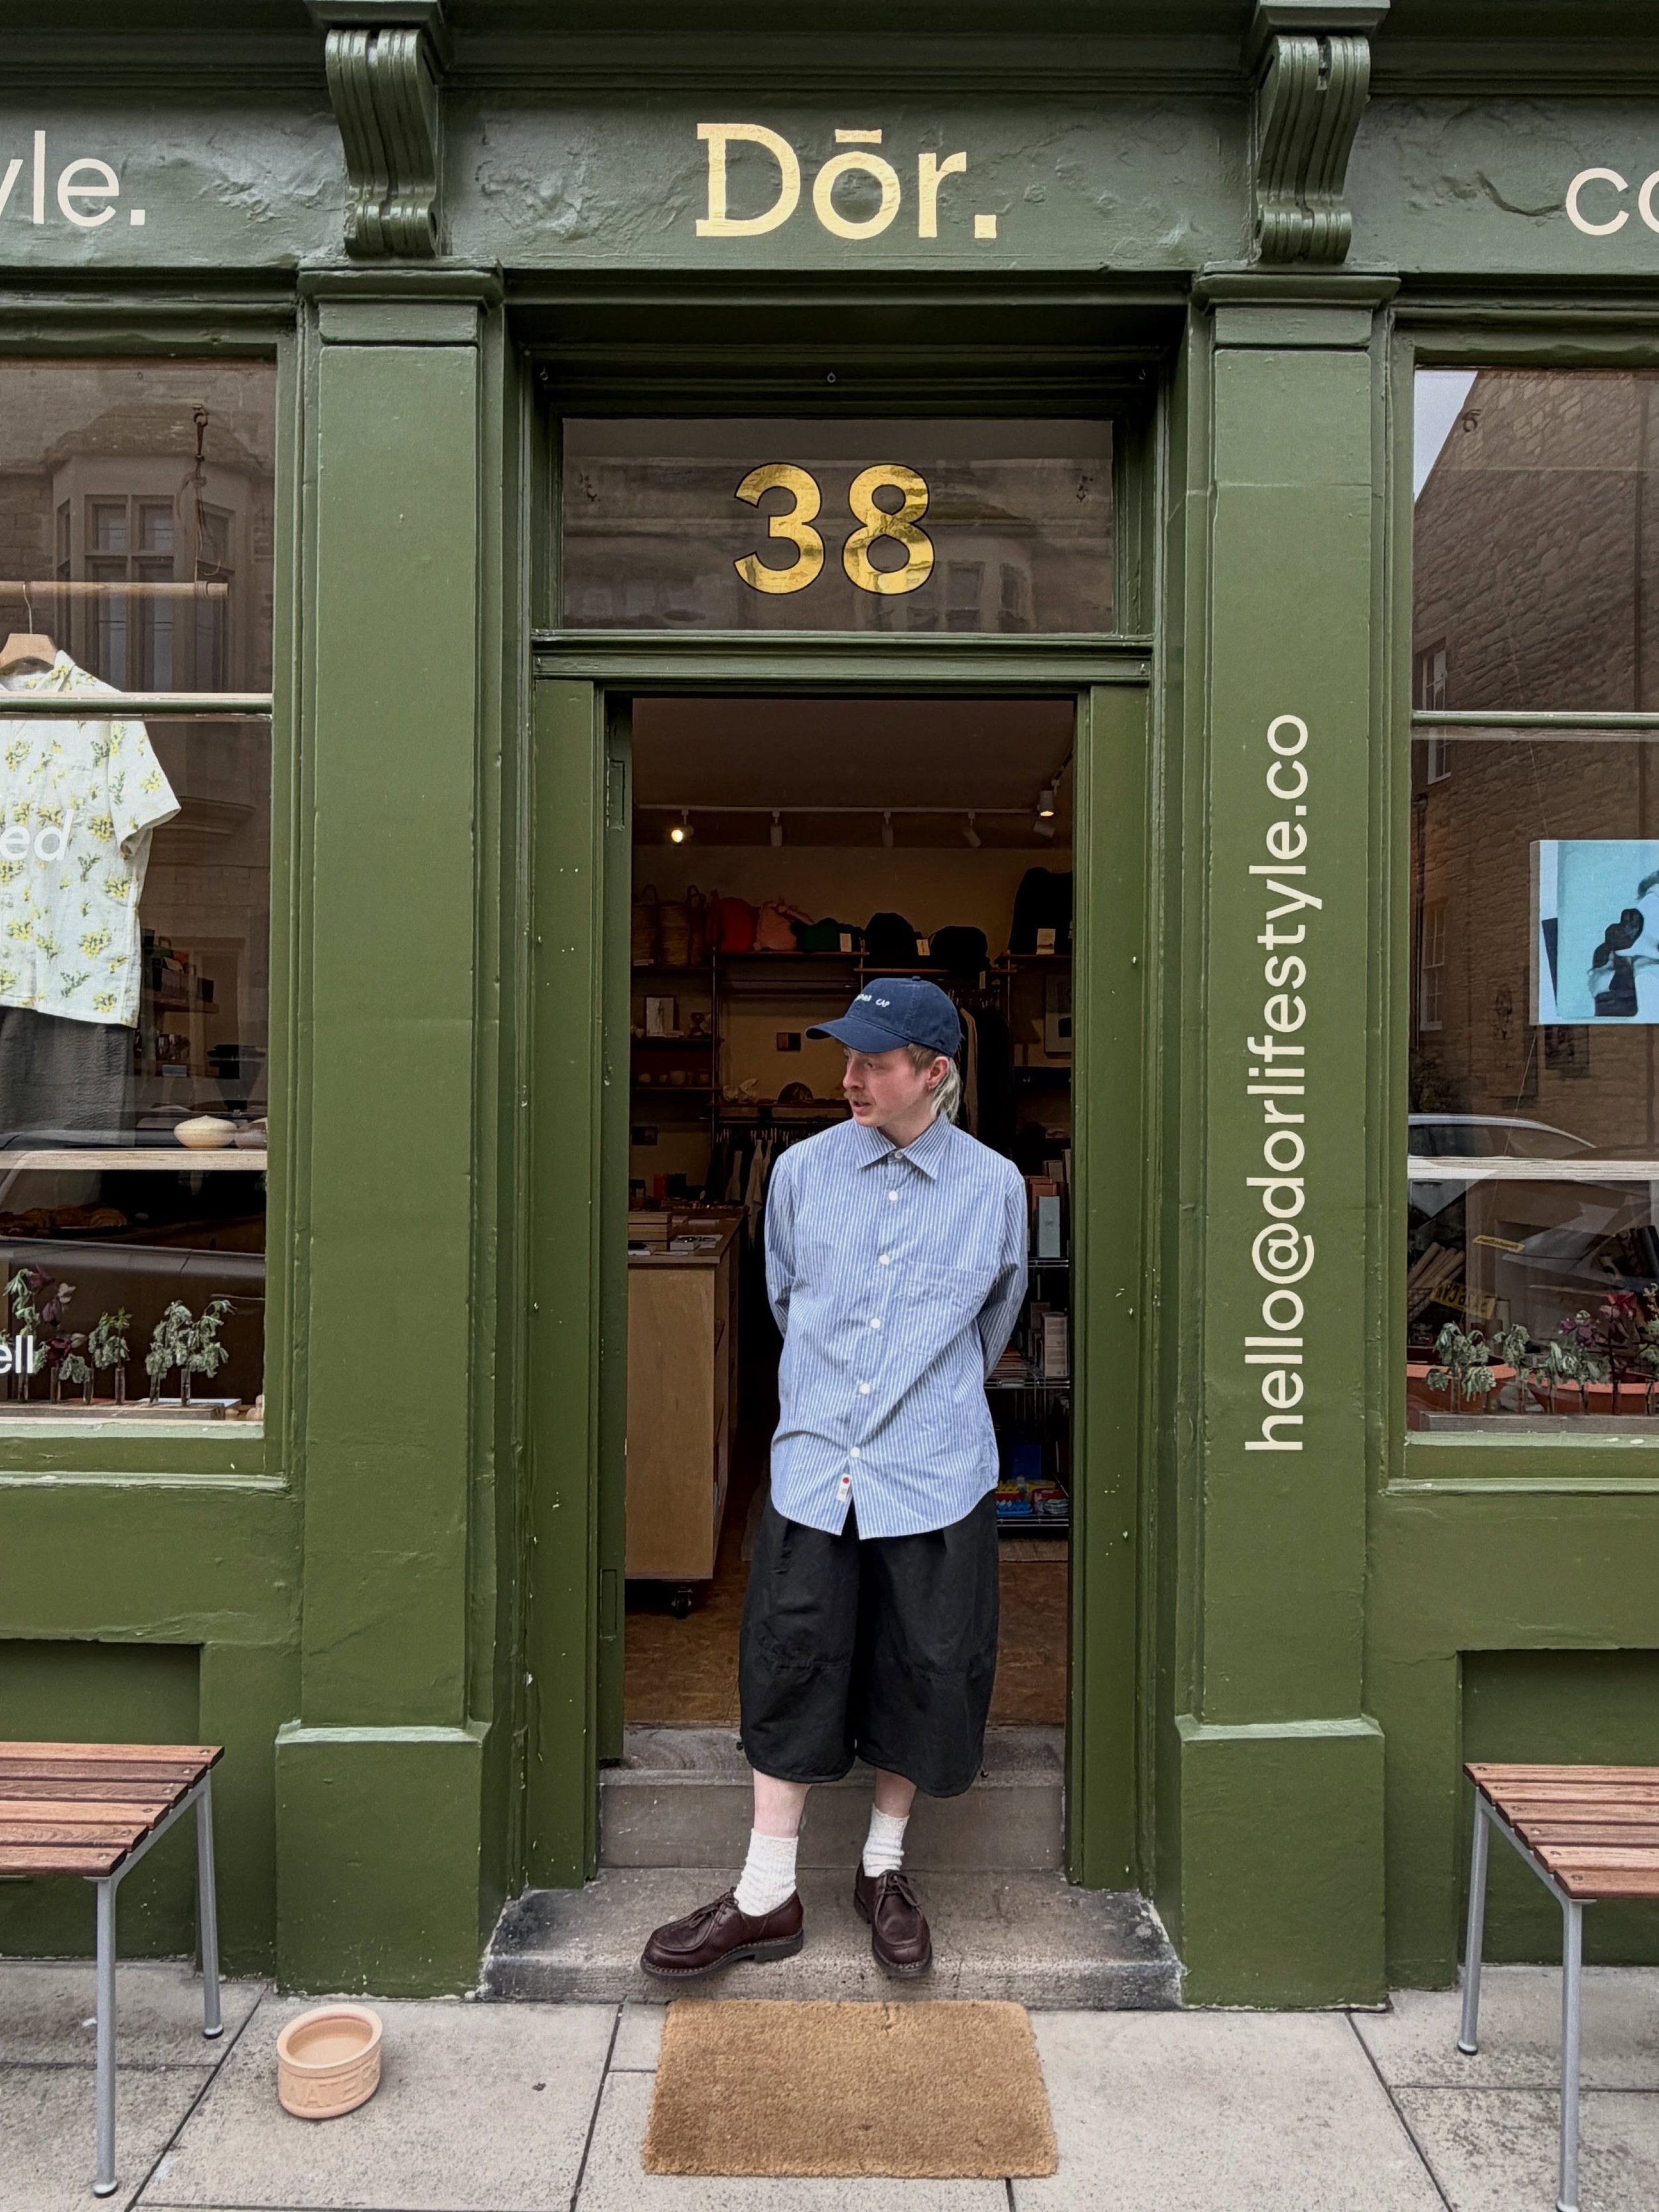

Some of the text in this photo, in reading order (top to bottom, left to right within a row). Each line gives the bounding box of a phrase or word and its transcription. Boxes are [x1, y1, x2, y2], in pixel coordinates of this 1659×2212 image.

[696, 123, 997, 240] Dōr.
[733, 463, 935, 595] 38
[1244, 714, 1323, 1451] hello@dorlifestyle.co
